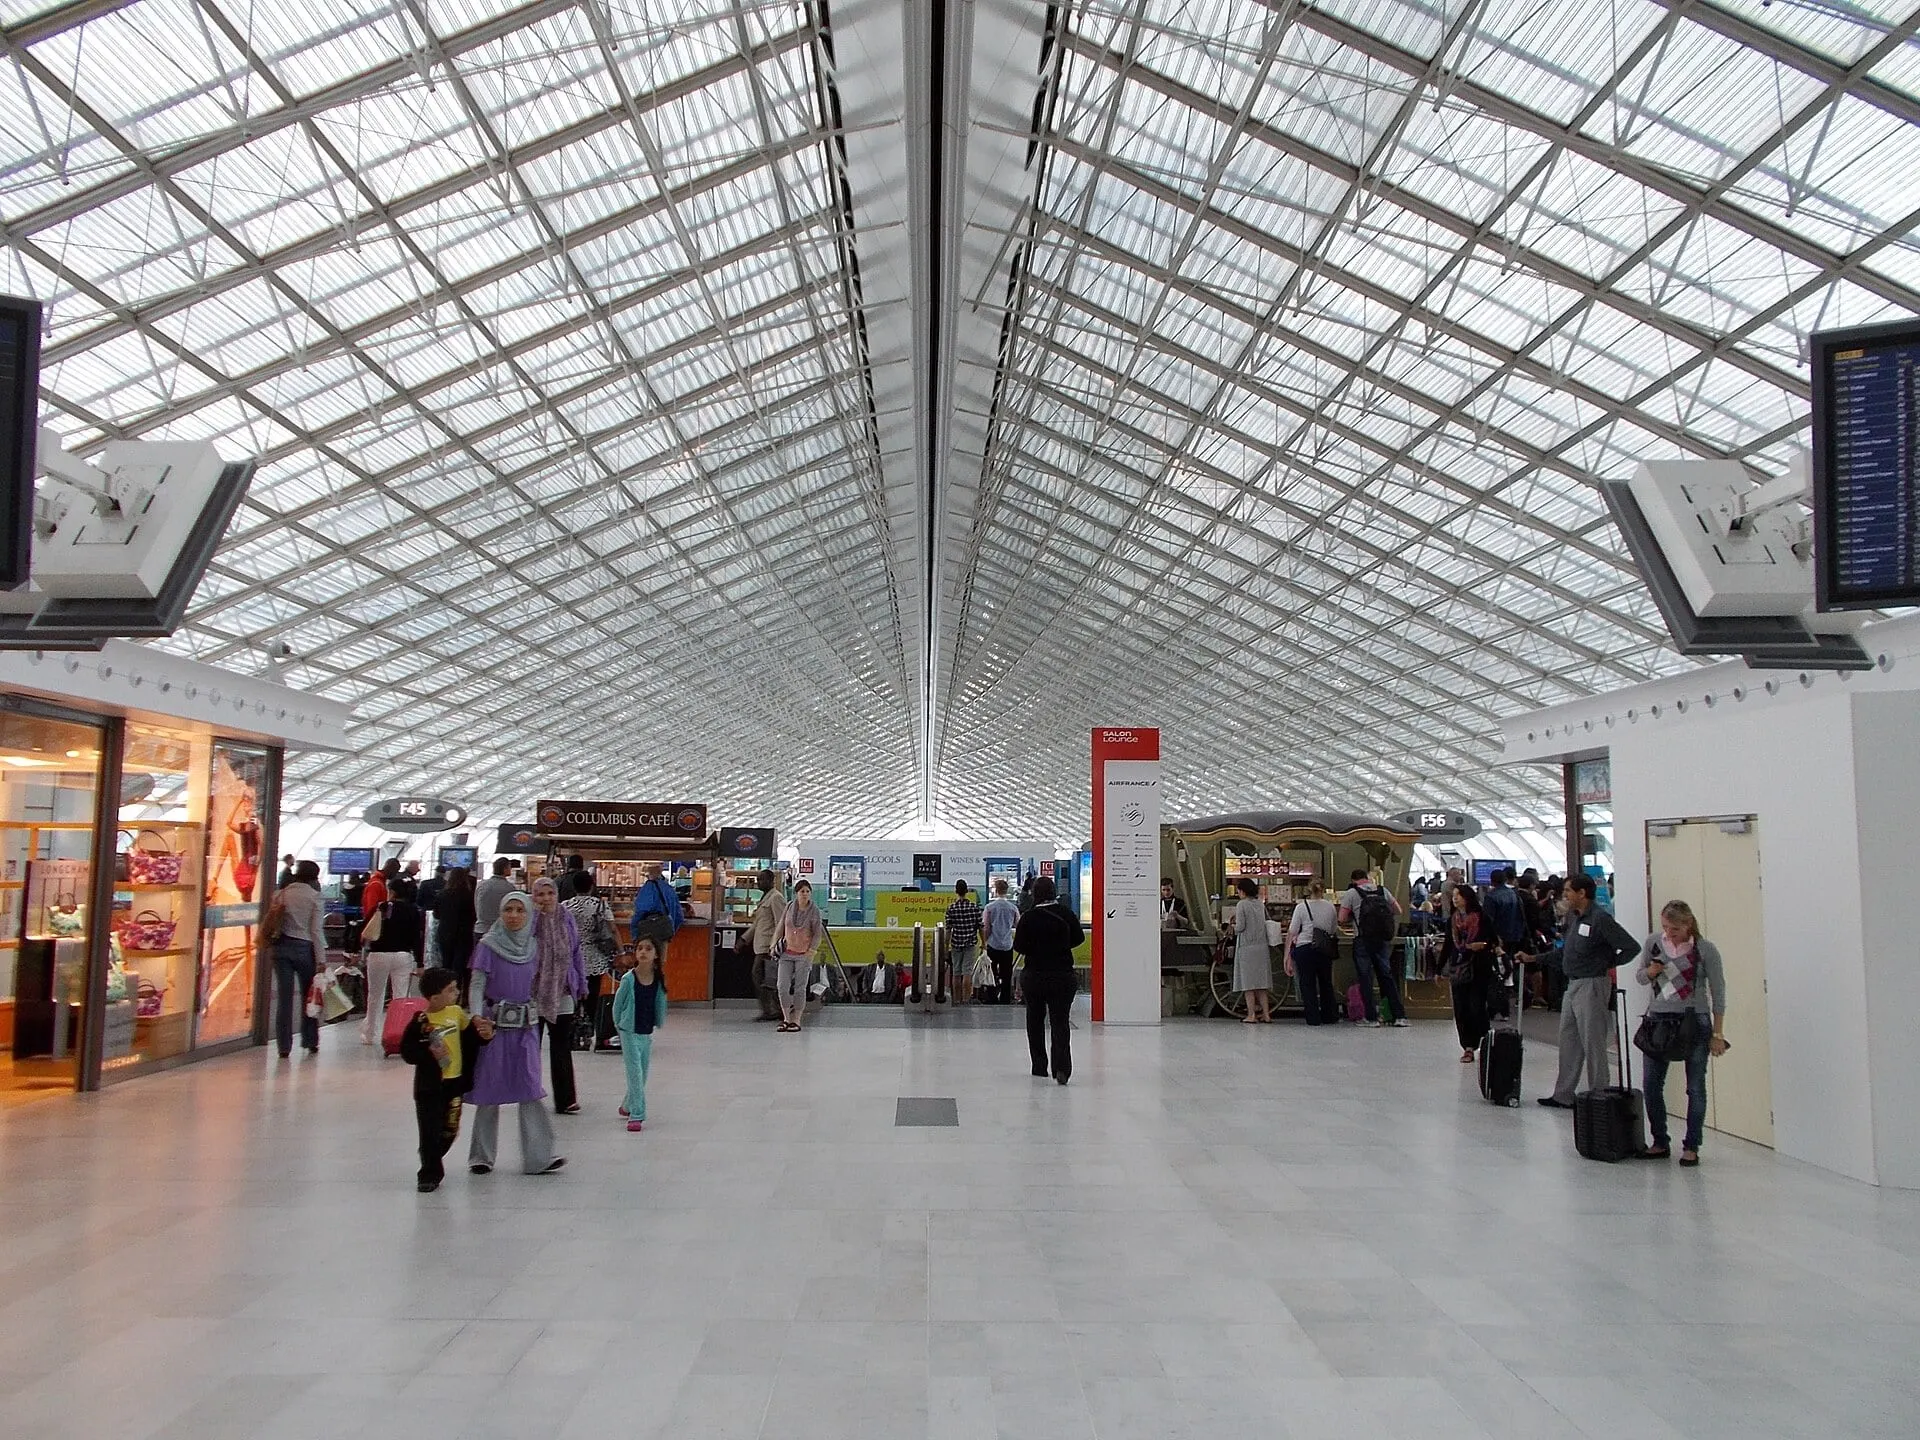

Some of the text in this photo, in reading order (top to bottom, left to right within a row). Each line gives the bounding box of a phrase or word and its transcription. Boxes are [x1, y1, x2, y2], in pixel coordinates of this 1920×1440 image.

[400, 802, 427, 815] F45
[566, 811, 636, 825] COLUMBUS
[638, 812, 670, 826] CAFÉ
[1420, 813, 1446, 827] F56
[800, 860, 813, 868] ICI
[891, 895, 927, 904] Boutiques
[928, 895, 944, 904] Duty
